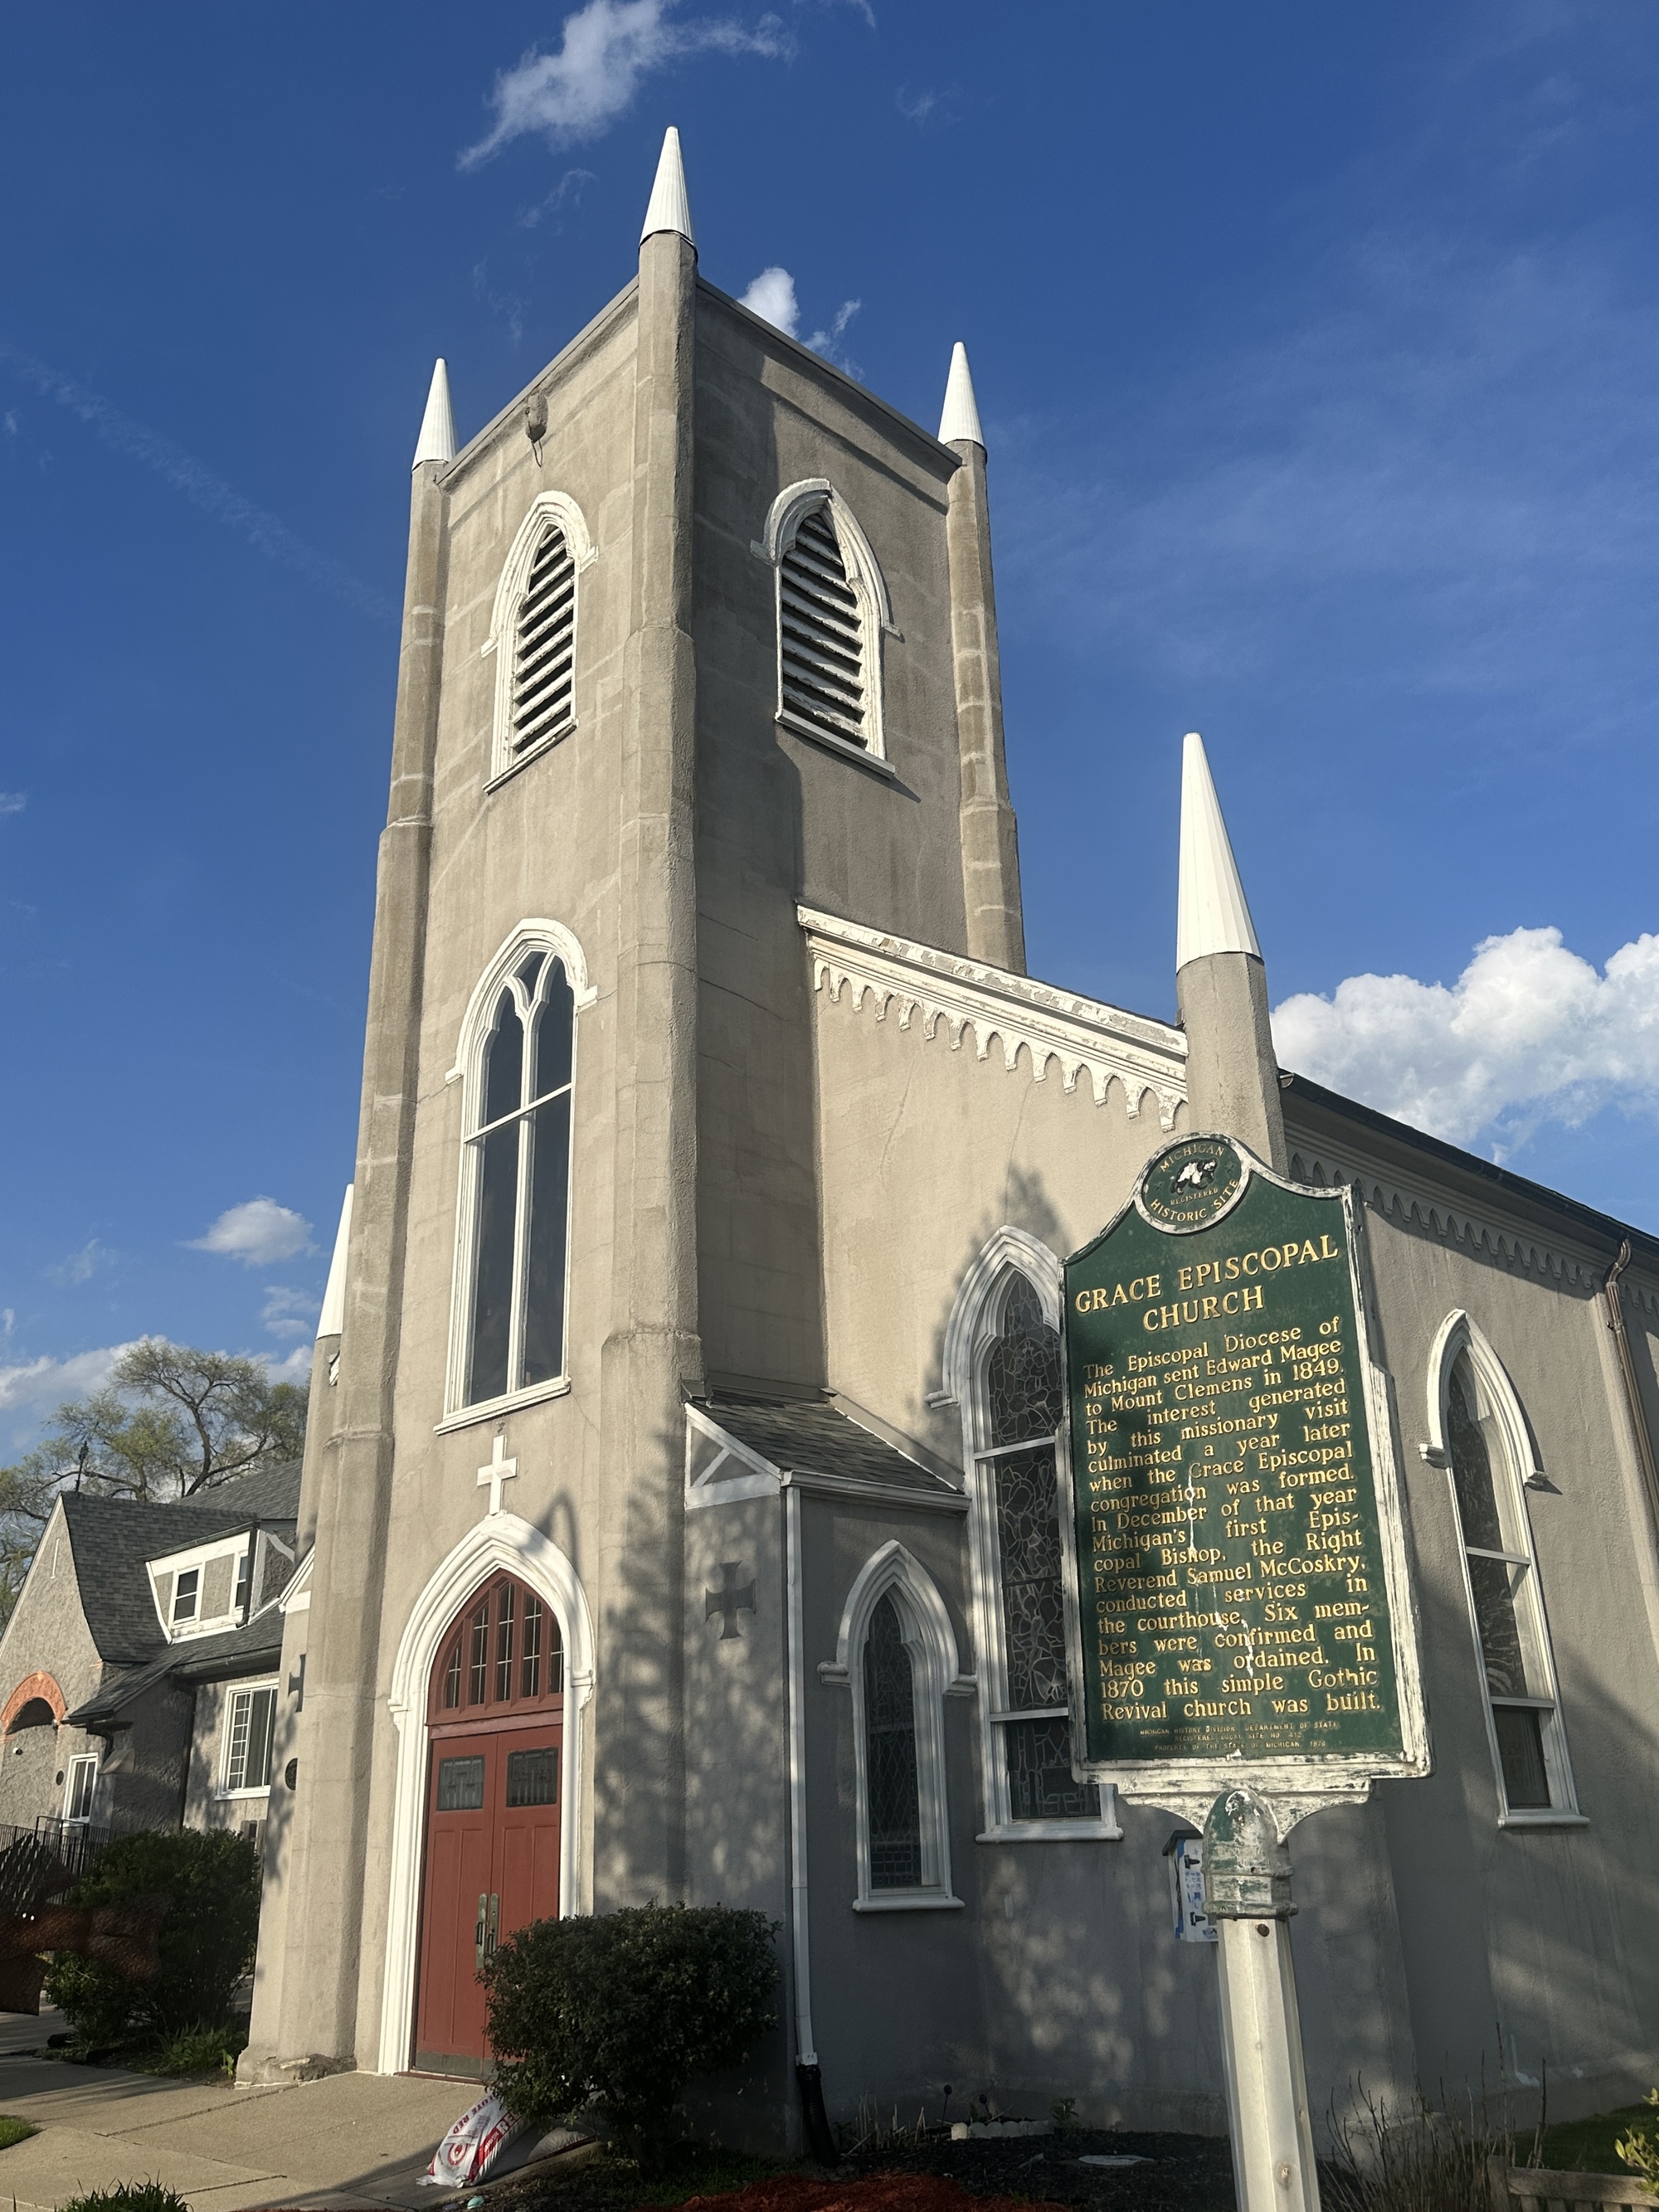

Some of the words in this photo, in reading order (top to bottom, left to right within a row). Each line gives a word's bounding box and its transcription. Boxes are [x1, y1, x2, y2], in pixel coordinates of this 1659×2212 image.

[1160, 1145, 1225, 1173] MICHIGAN
[1150, 1198, 1208, 1222] HISTORIC
[1213, 1179, 1238, 1209] SITE
[1170, 1187, 1219, 1206] REGISTERED
[1075, 1274, 1161, 1313] GRACE
[1178, 1234, 1339, 1291] EPISCOPAL
[1142, 1285, 1264, 1331] CHURCH
[1082, 1364, 1114, 1380] The
[1127, 1341, 1209, 1373] Episcopal
[1224, 1327, 1301, 1353] Diocese
[1319, 1315, 1340, 1335] of
[1084, 1374, 1157, 1399] Michigan
[1164, 1364, 1199, 1384] sent
[1207, 1349, 1273, 1376] Edward
[1280, 1339, 1341, 1364] Magee
[1086, 1403, 1102, 1417] to
[1112, 1389, 1163, 1412] Mount
[1175, 1376, 1253, 1401] Clemens
[1263, 1369, 1282, 1386] in
[1293, 1358, 1345, 1381] 1849.
[1086, 1419, 1117, 1436] The
[1147, 1399, 1216, 1426] interest
[1248, 1378, 1346, 1413] generated
[1087, 1440, 1107, 1456] by
[1130, 1429, 1161, 1448] this
[1180, 1412, 1278, 1440] missionary
[1305, 1398, 1348, 1421] visit
[1087, 1445, 1182, 1473] culminated
[1204, 1444, 1214, 1456] a
[1236, 1433, 1280, 1456] year
[1303, 1422, 1350, 1442] later
[1089, 1475, 1133, 1492] when
[1147, 1468, 1176, 1485] the
[1190, 1459, 1244, 1478] Grace
[1258, 1440, 1353, 1472] Episcopal
[1090, 1484, 1207, 1513] congregation
[1225, 1479, 1260, 1495] was
[1278, 1462, 1355, 1489] formed.
[1092, 1516, 1107, 1533] In
[1117, 1506, 1207, 1530] December
[1220, 1498, 1241, 1517] of
[1255, 1492, 1295, 1513] that
[1310, 1487, 1357, 1510] year
[1092, 1529, 1186, 1553] Michigan's
[1225, 1517, 1267, 1538] first
[1308, 1507, 1360, 1531] Epis-
[1093, 1553, 1141, 1573] copal
[1161, 1547, 1227, 1566] Bishop,
[1251, 1539, 1284, 1557] the
[1306, 1529, 1362, 1553] Right
[1095, 1568, 1177, 1593] Reverend
[1187, 1562, 1252, 1586] Samuel
[1259, 1553, 1365, 1578] McCoskry,
[1096, 1590, 1188, 1613] conducted
[1224, 1582, 1306, 1602] services
[1345, 1573, 1368, 1593] in
[1097, 1617, 1125, 1635] the
[1264, 1602, 1298, 1622] Six
[1314, 1601, 1370, 1619] mem-
[1098, 1639, 1137, 1655] bers
[1153, 1636, 1197, 1652] were
[1214, 1624, 1316, 1648] confirmed
[1334, 1619, 1373, 1641] and
[1099, 1660, 1156, 1680] Magee
[1177, 1658, 1212, 1672] was
[1233, 1646, 1330, 1669] ordained.
[1355, 1642, 1375, 1662] In
[1101, 1679, 1144, 1699] 1870
[1163, 1677, 1199, 1696] this
[1221, 1672, 1284, 1696] simple
[1308, 1666, 1378, 1688] Gothic
[1102, 1701, 1167, 1720] Revival
[1183, 1698, 1251, 1718] church
[1272, 1699, 1308, 1714] was
[1326, 1690, 1381, 1711] built.
